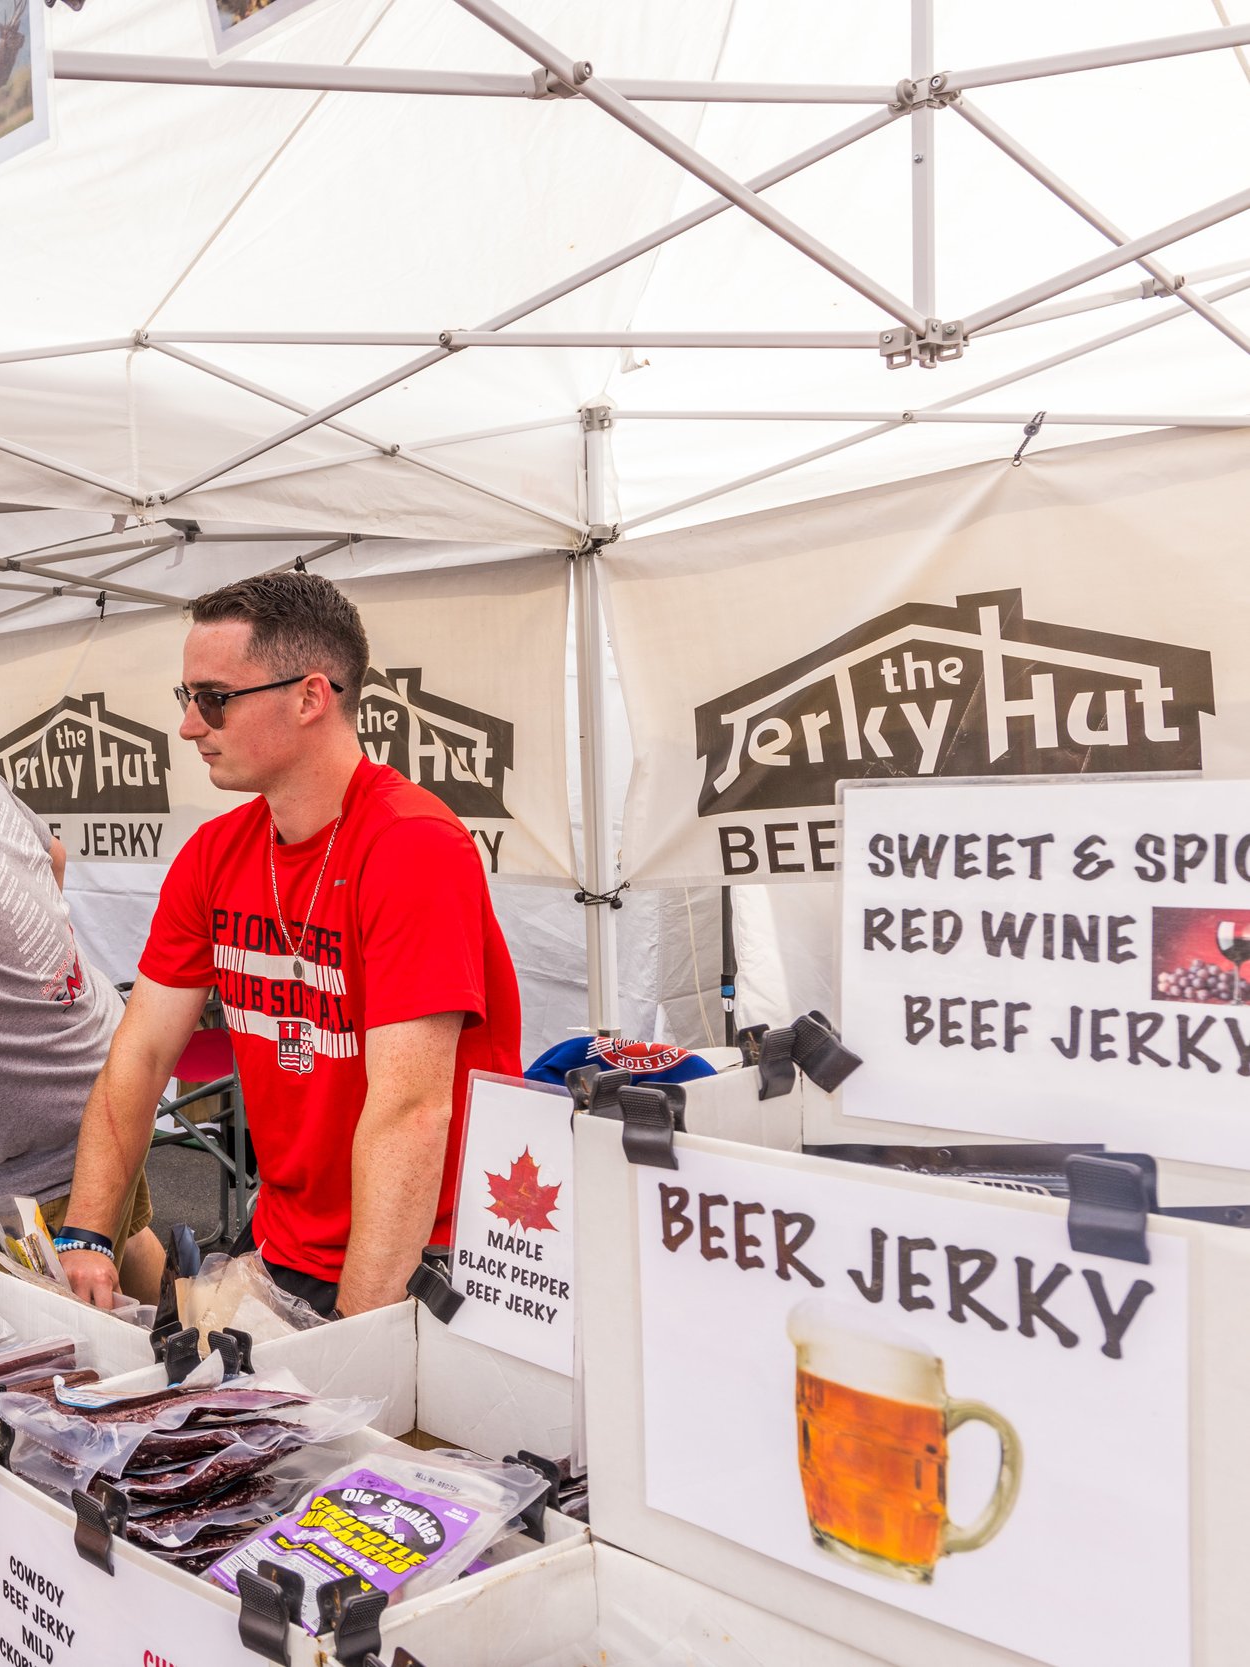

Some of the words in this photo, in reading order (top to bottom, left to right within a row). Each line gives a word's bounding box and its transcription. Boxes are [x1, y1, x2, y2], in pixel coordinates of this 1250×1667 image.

[880, 651, 963, 694] the
[55, 725, 87, 750] the
[357, 703, 399, 733] the
[408, 695, 494, 787] Hut
[713, 668, 953, 794] Jerky
[982, 640, 1180, 763] Hut
[91, 722, 161, 793] Hut
[80, 823, 163, 857] JERKY
[718, 820, 839, 876] BEE
[867, 832, 1054, 881] SWEET
[1072, 834, 1115, 881] &
[863, 906, 964, 955] RED
[981, 909, 1138, 964] WINE
[655, 1047, 679, 1067] AST
[904, 994, 1032, 1053] BEEF
[1050, 1005, 1250, 1077] JERKY
[617, 1056, 653, 1070] STOP
[487, 1229, 544, 1262] MAPLE
[657, 1181, 826, 1289] BEER
[846, 1226, 1155, 1360] JERKY
[458, 1249, 507, 1281] BLACK
[510, 1265, 570, 1301] PEPPER
[465, 1279, 502, 1306] BEEF
[505, 1292, 558, 1325] JERKY
[295, 1510, 413, 1575] HABANERO
[309, 1495, 429, 1568] CHIPOTLE
[381, 1498, 443, 1546] Smokies
[9, 1555, 65, 1608] COWBOY
[323, 1540, 380, 1577] Sticks
[2, 1579, 30, 1616] BEEF
[32, 1603, 76, 1648] JERKY
[21, 1624, 54, 1665] MILD
